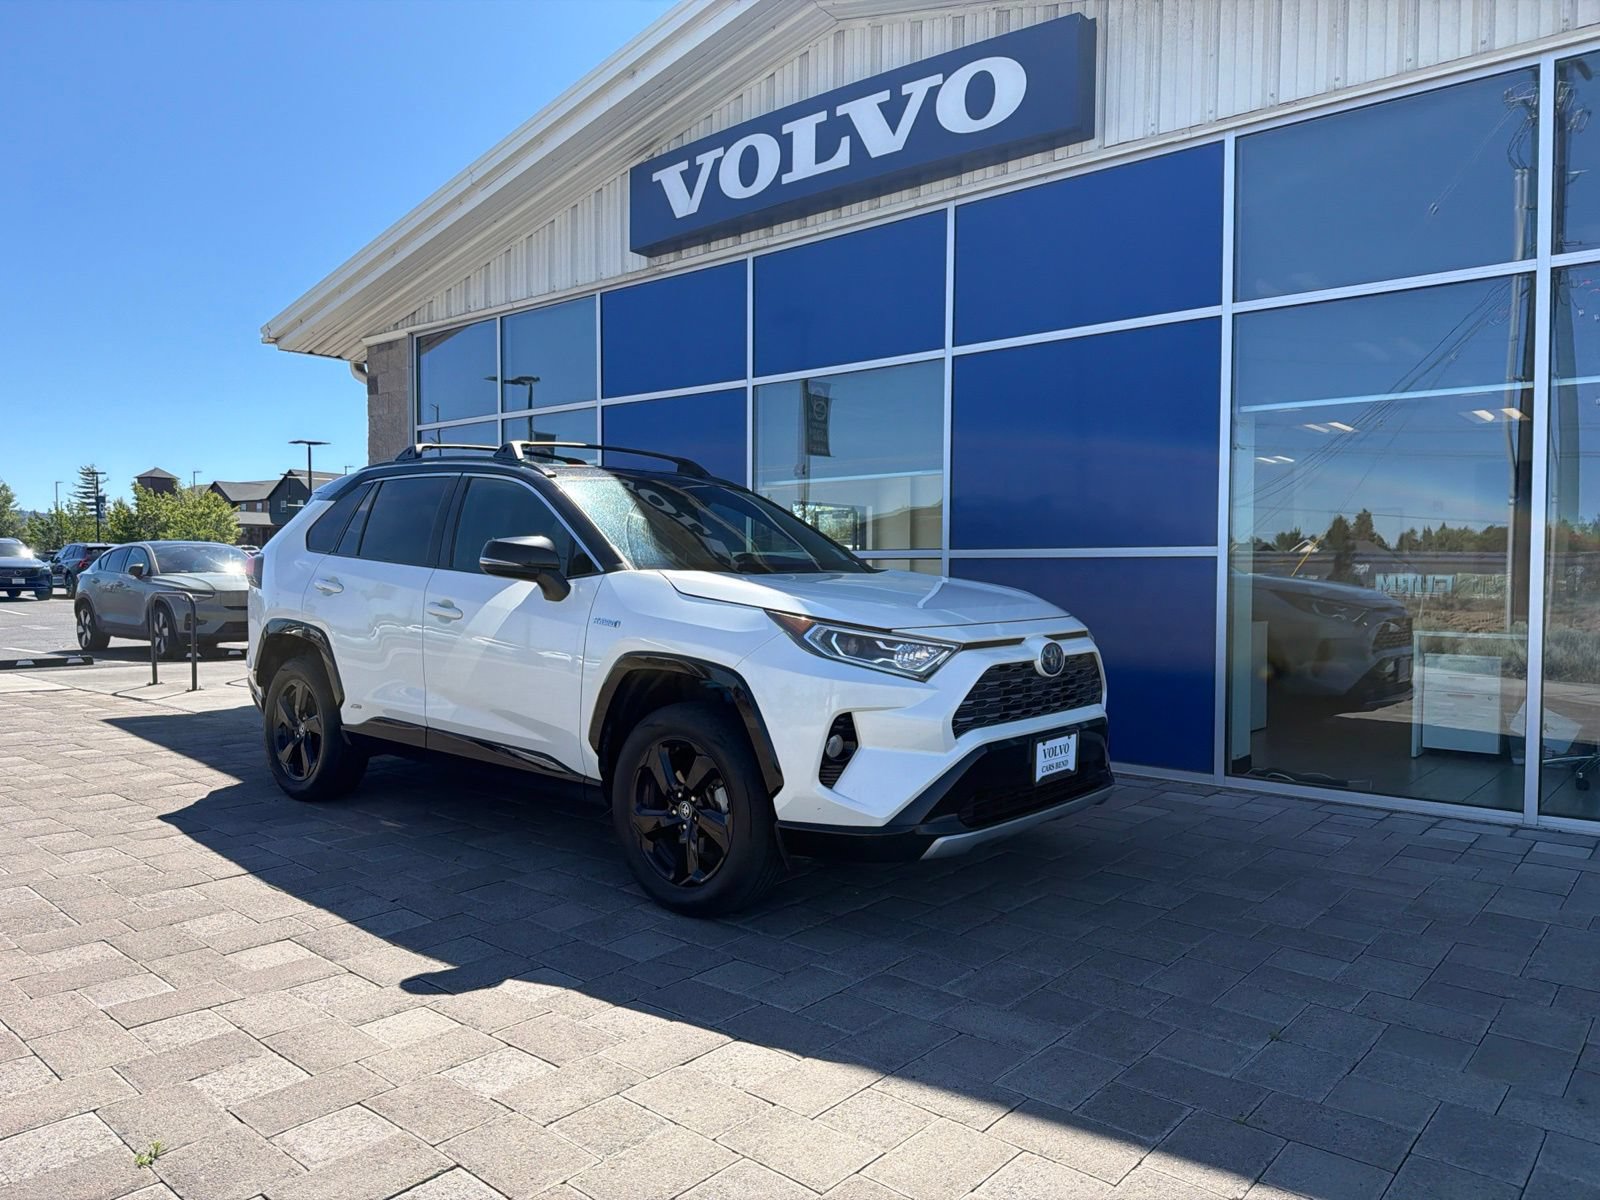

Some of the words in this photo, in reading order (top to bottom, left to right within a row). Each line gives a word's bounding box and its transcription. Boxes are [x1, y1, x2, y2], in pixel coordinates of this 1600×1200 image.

[652, 56, 1028, 219] VOLVO
[1042, 743, 1070, 758] VOLVO
[1041, 763, 1055, 773] CARS
[1055, 759, 1069, 769] BEND
